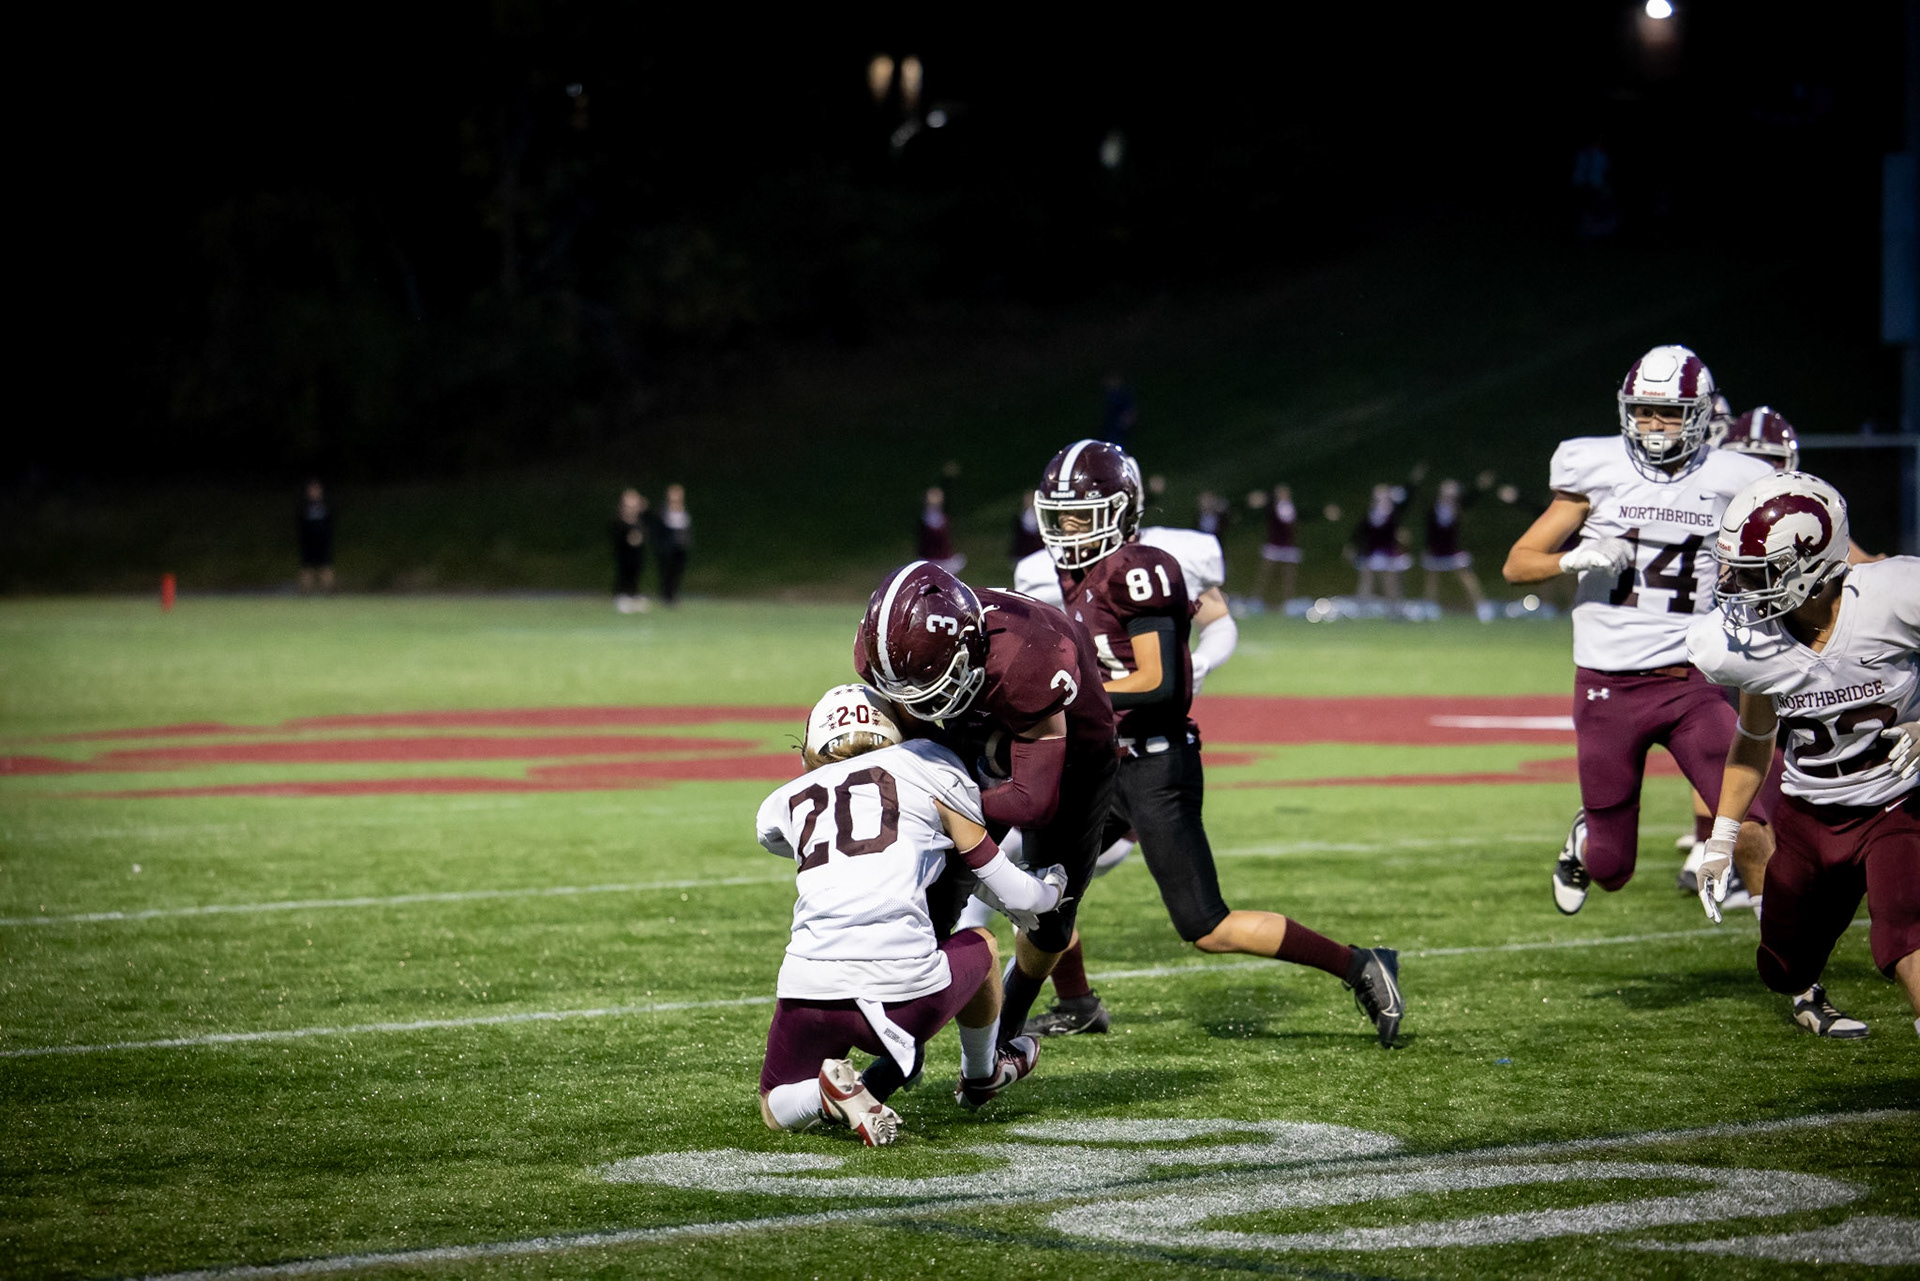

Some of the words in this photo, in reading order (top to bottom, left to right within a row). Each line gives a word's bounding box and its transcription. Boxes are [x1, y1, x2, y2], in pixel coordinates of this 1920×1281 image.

[1619, 505, 1714, 527] NORTHBRIDGE
[1125, 564, 1171, 601] 81
[1609, 527, 1704, 614] 14
[926, 614, 958, 636] 3
[1050, 669, 1078, 706] 3
[1777, 680, 1885, 710] NORTHBRIDGE
[836, 704, 870, 727] 20
[789, 766, 900, 875] 20
[598, 1116, 1866, 1252] 30
